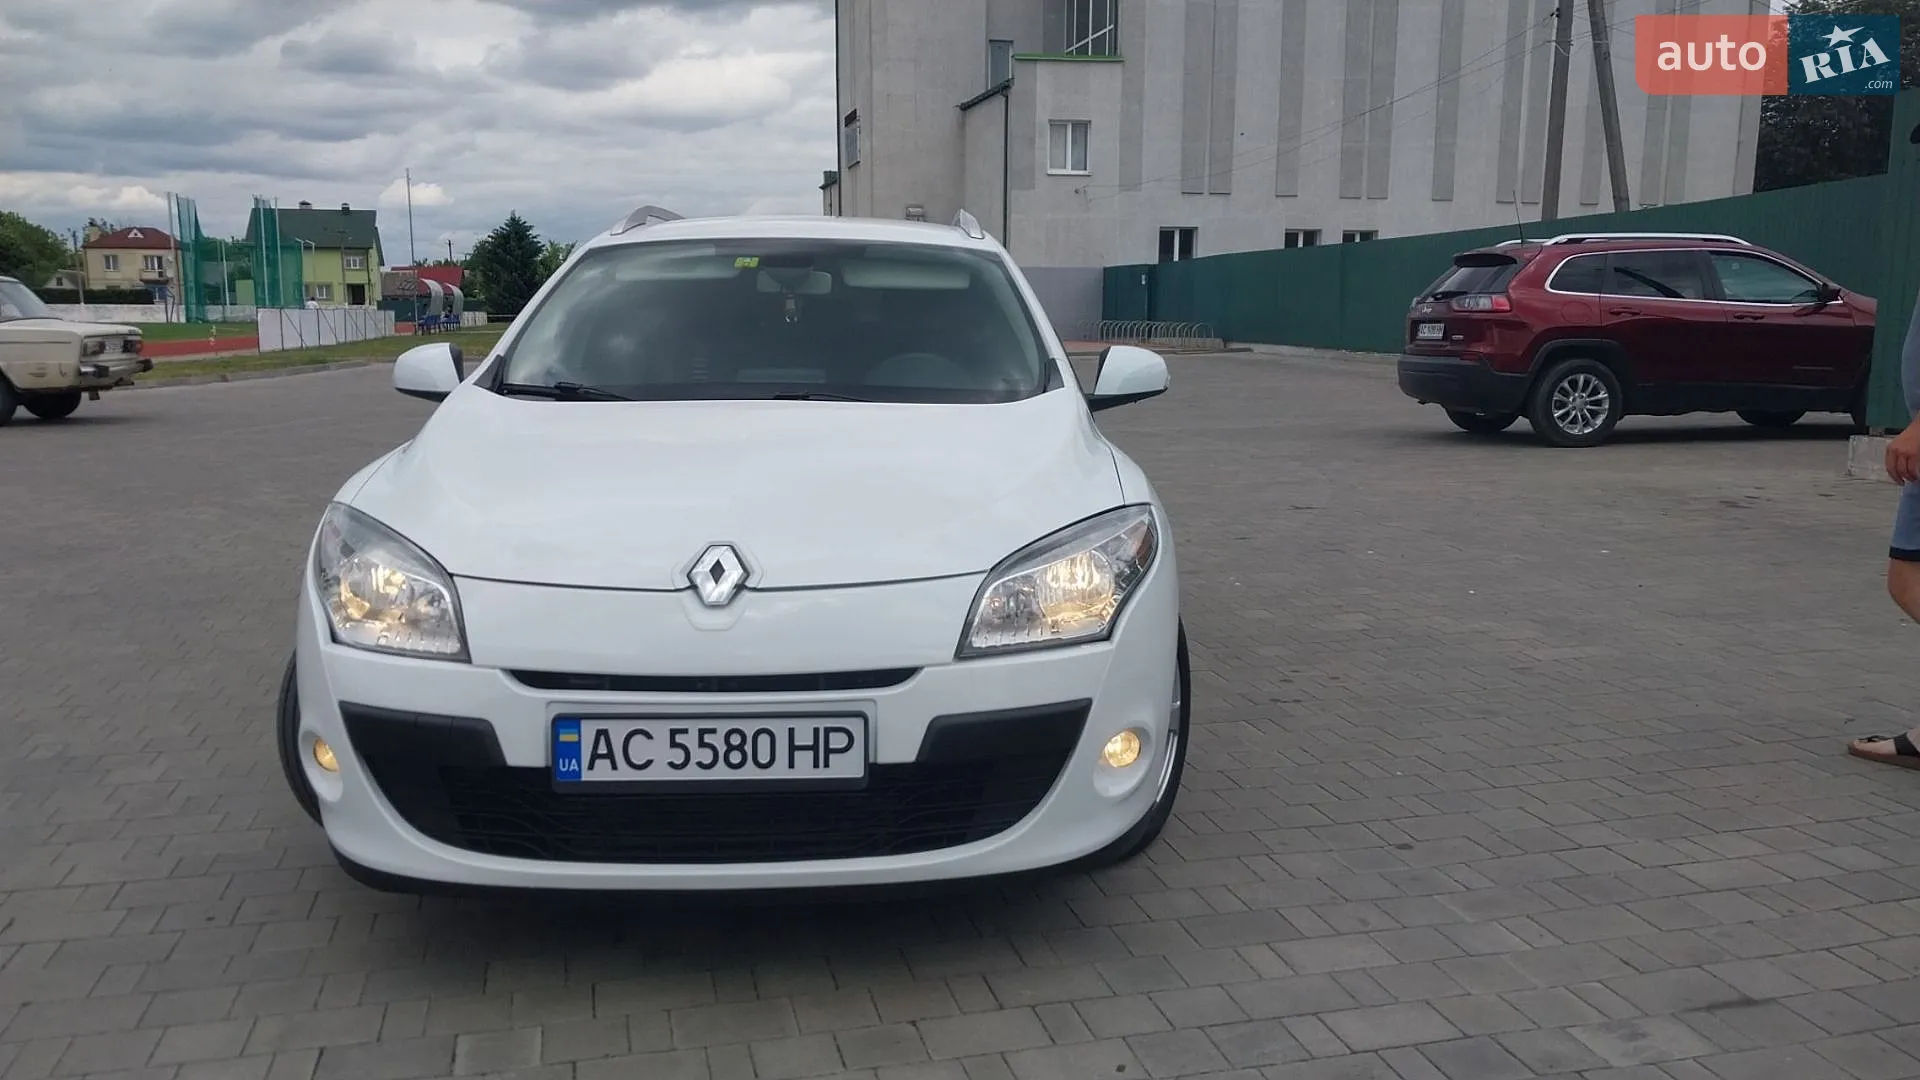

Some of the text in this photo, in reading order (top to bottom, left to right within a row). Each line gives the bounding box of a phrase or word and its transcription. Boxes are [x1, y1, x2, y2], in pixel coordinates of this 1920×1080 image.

[587, 726, 855, 771] AC 5580 HP
[559, 759, 579, 772] UA
